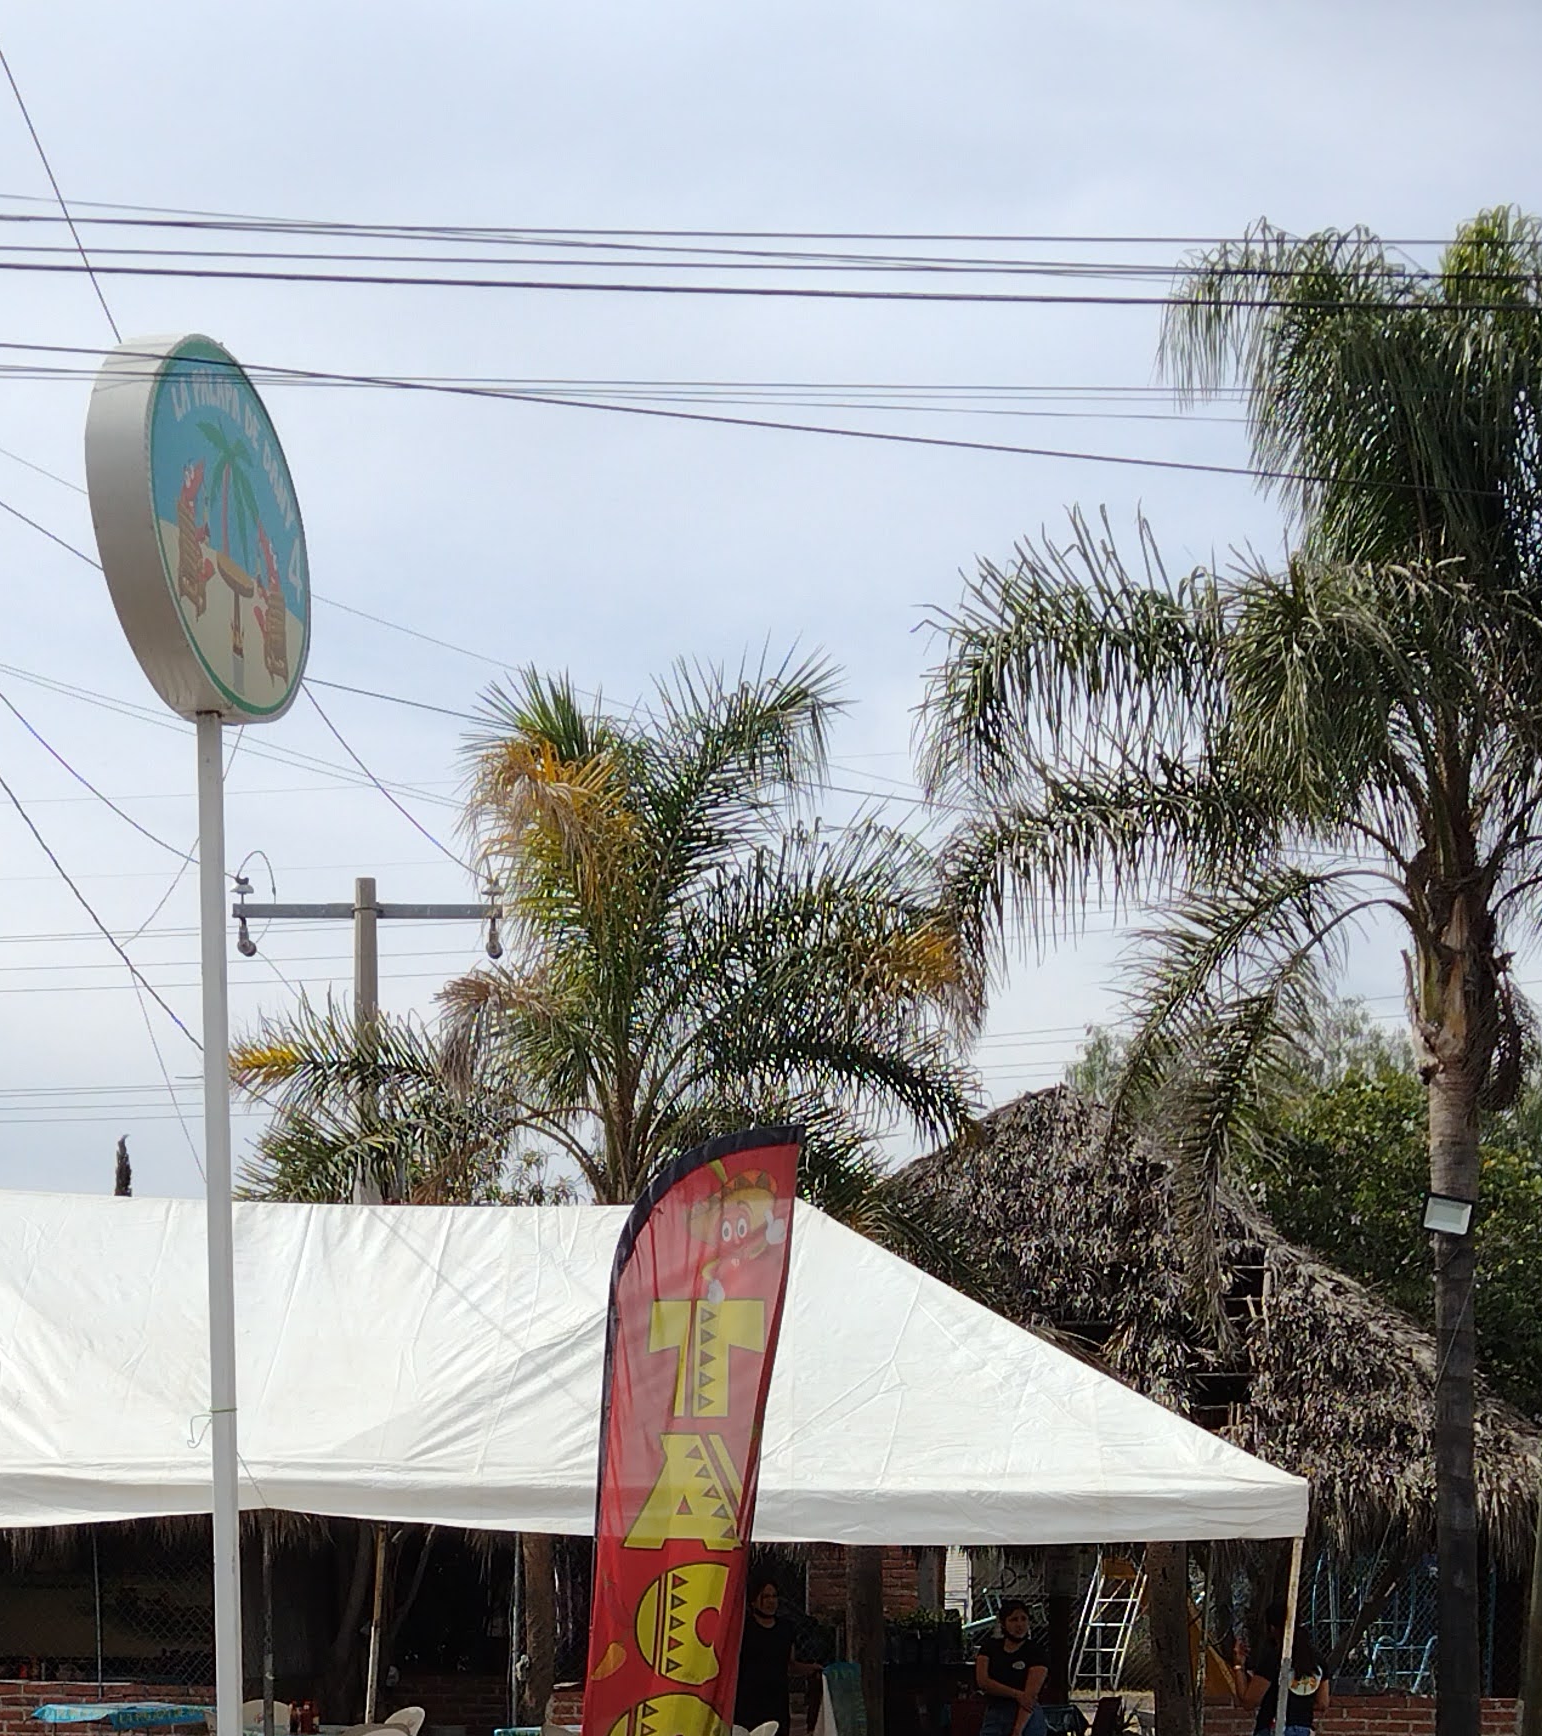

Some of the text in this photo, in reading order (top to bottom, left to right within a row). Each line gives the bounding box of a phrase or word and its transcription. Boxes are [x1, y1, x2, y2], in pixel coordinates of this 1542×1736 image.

[171, 370, 303, 603] LA PALAPA DE DANY 4
